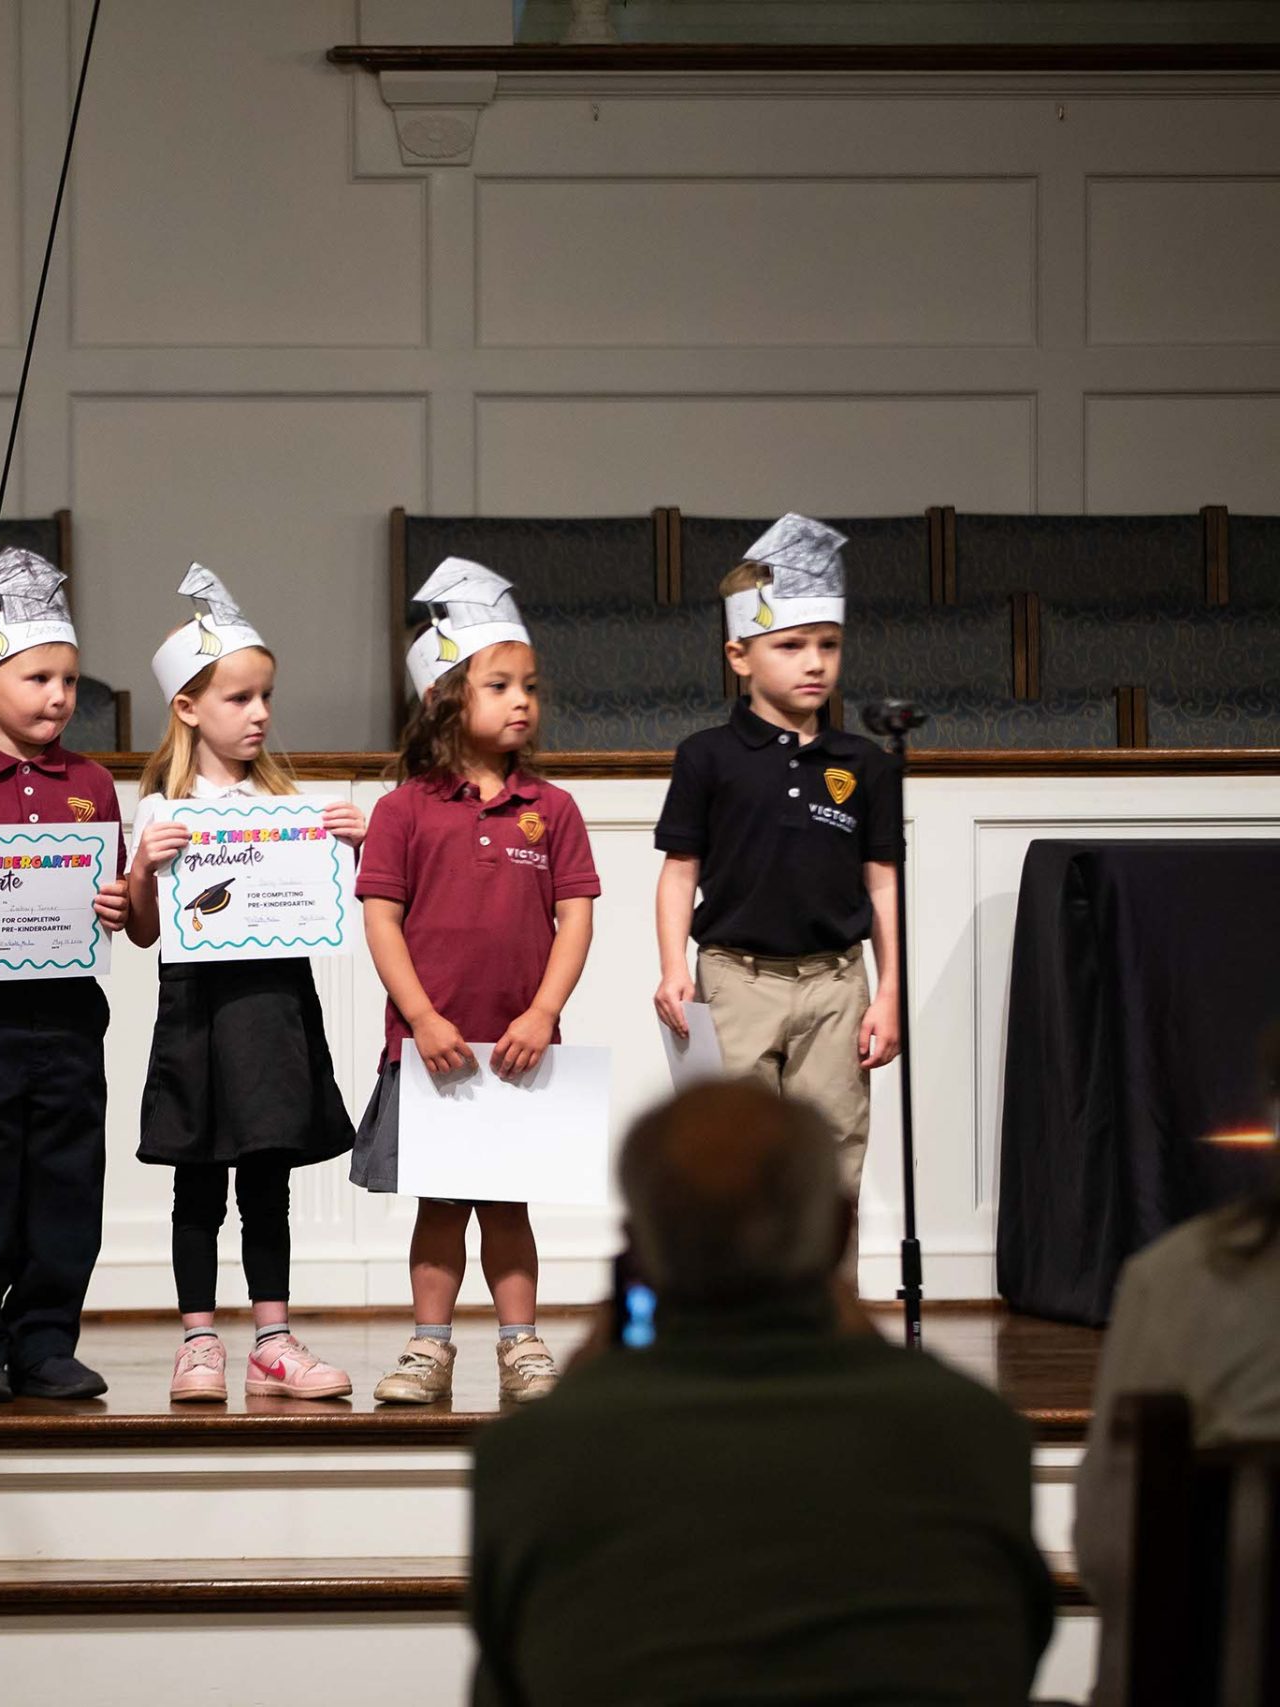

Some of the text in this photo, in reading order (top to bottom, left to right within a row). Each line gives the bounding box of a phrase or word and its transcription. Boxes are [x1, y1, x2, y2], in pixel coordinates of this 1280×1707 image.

[189, 826, 327, 845] RE-KINDERGARTEN
[184, 844, 264, 871] graduate
[261, 891, 304, 899] COMPLETING
[1, 925, 71, 933] PRE-KINDERGARTEN!
